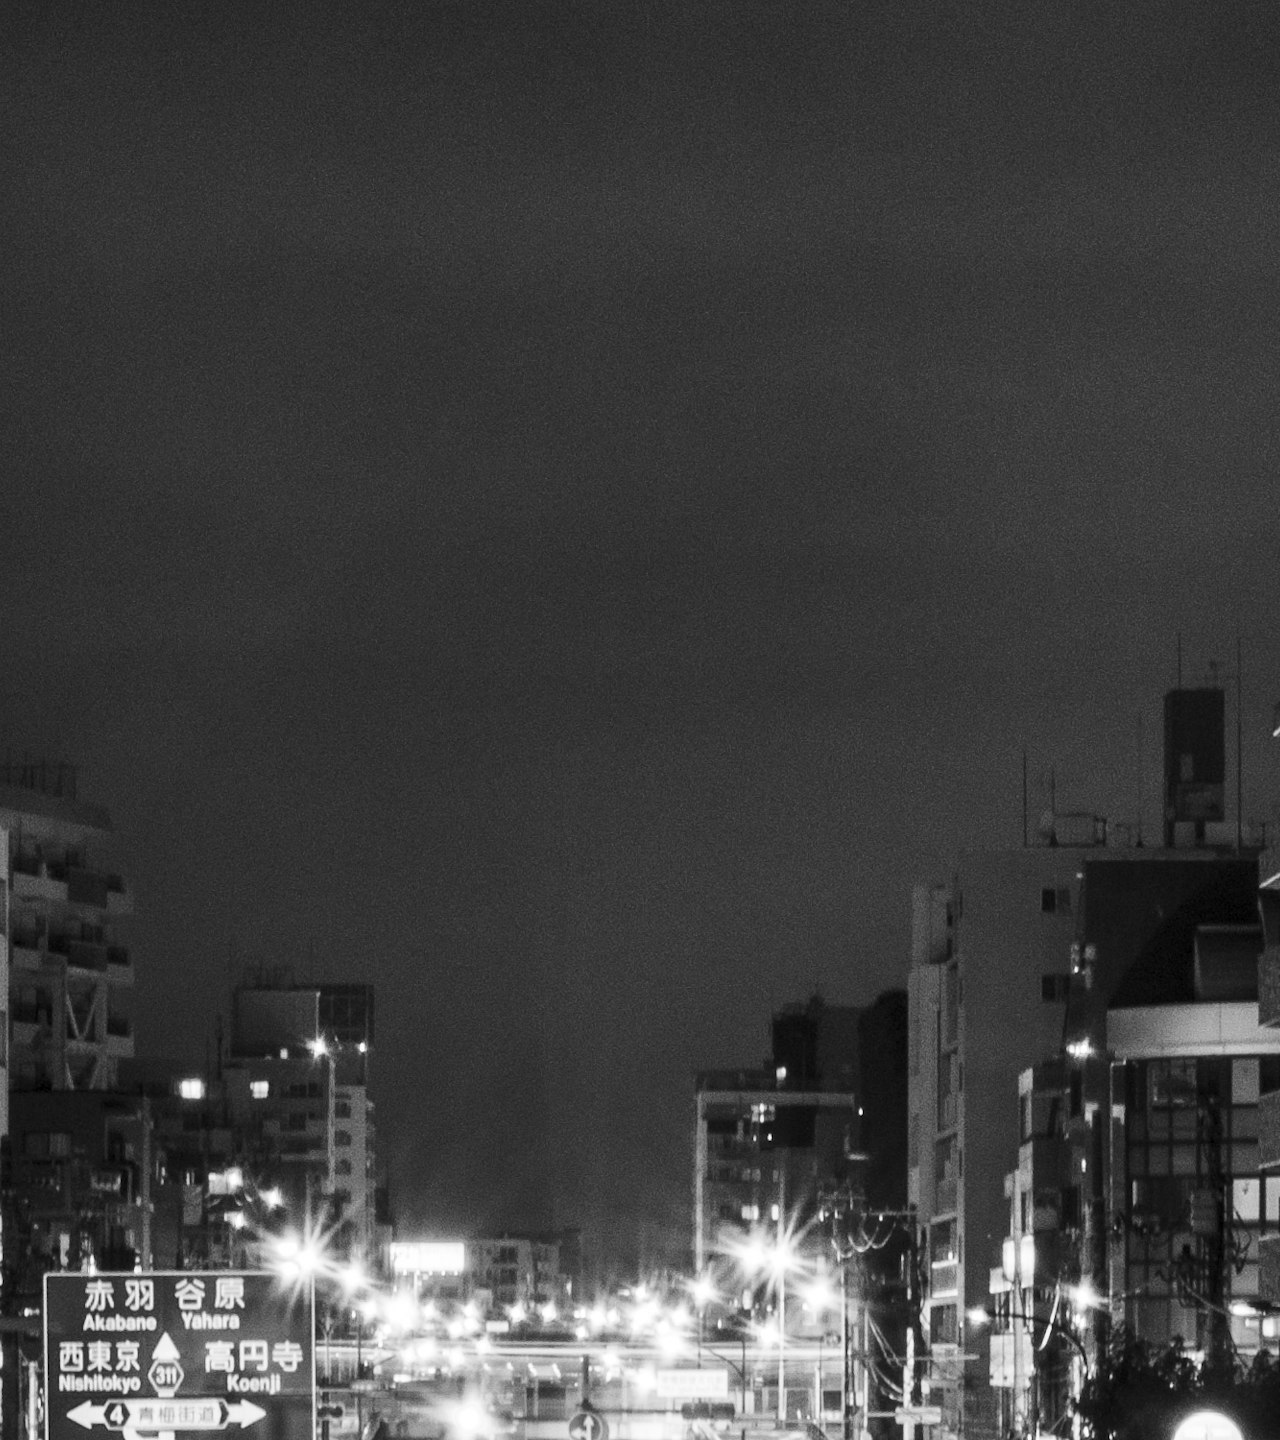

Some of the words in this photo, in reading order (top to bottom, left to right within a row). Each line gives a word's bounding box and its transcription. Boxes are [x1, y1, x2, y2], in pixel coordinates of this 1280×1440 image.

[84, 1278, 155, 1311] 赤羽
[174, 1277, 245, 1310] 谷原
[82, 1313, 157, 1331] Akabane
[181, 1311, 240, 1330] Yahara
[58, 1340, 141, 1372] 西東京
[204, 1339, 304, 1373] 高円寺
[58, 1374, 141, 1394] Nishitokyo
[155, 1366, 177, 1385] 311
[227, 1374, 281, 1395] Koenji
[109, 1407, 124, 1422] 4
